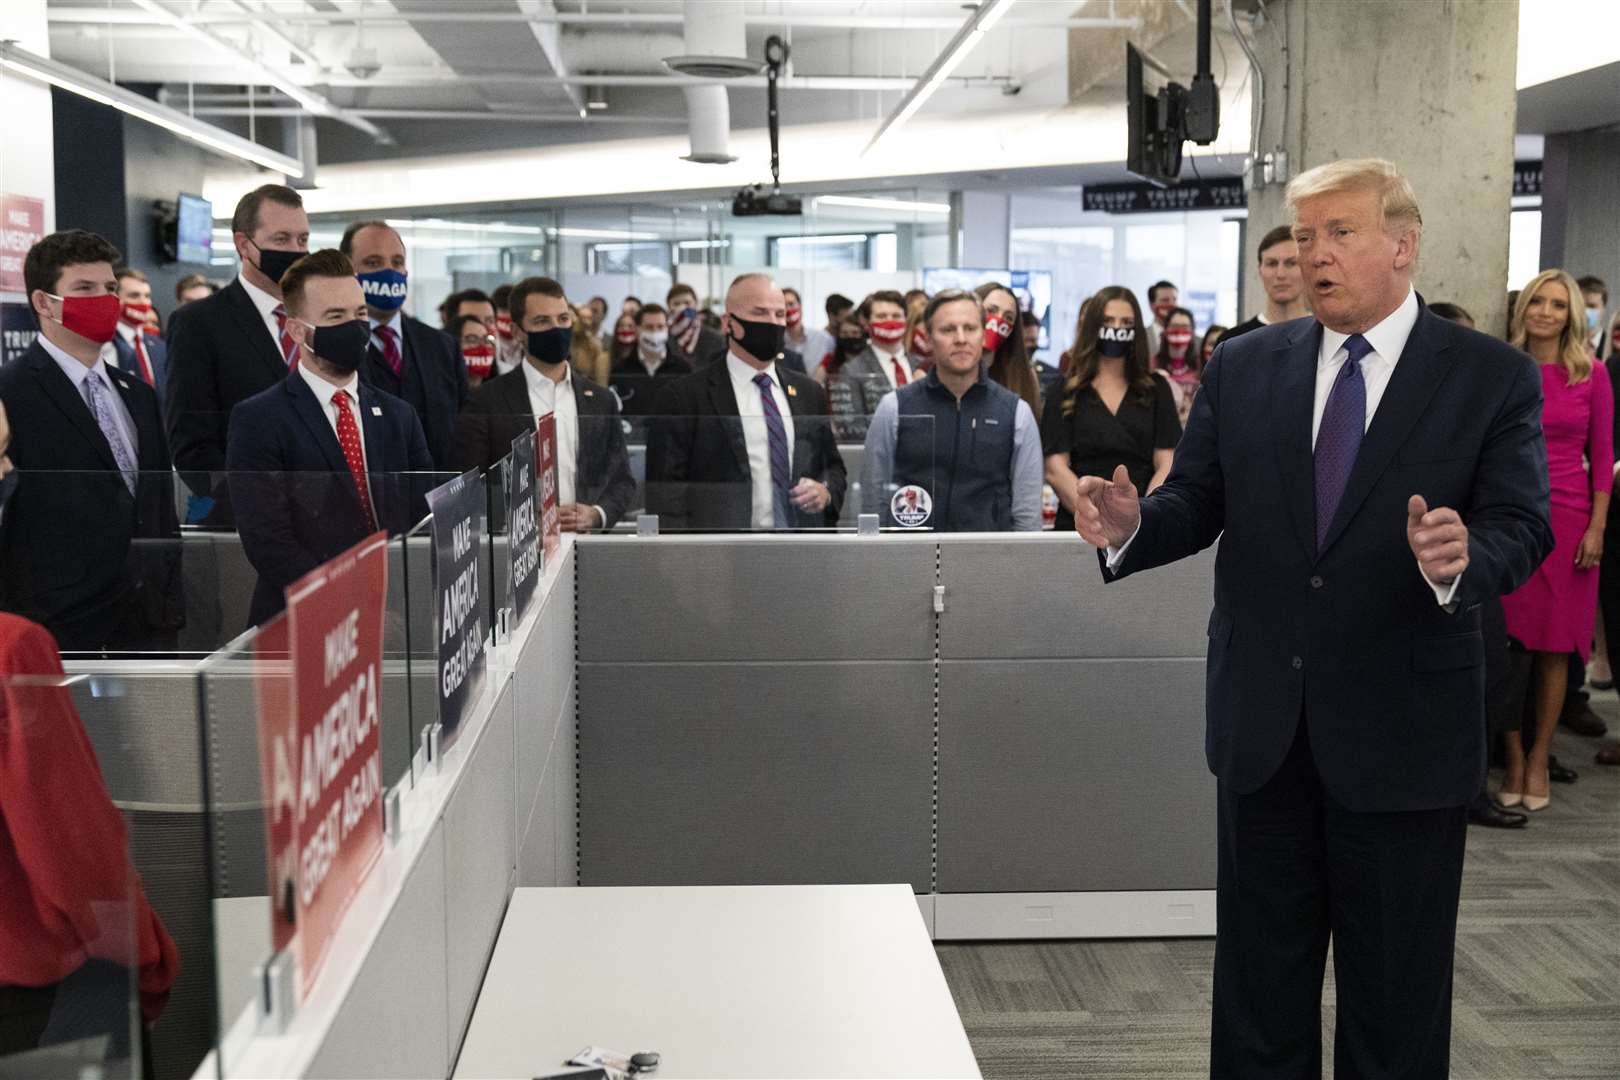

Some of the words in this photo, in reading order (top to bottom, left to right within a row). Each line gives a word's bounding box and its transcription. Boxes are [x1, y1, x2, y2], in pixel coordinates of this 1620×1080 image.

[1146, 188, 1200, 200] TRUMP
[362, 279, 407, 297] MAGA
[452, 516, 471, 563] MAKE
[512, 495, 535, 549] AMERICA
[441, 556, 479, 645] AMERICA
[324, 608, 359, 688] MAKE
[442, 638, 467, 699] GREAT
[465, 616, 483, 664] AGAIN
[299, 663, 378, 824] AMERICA
[301, 799, 340, 905] GREAT
[341, 749, 379, 842] AGAIN
